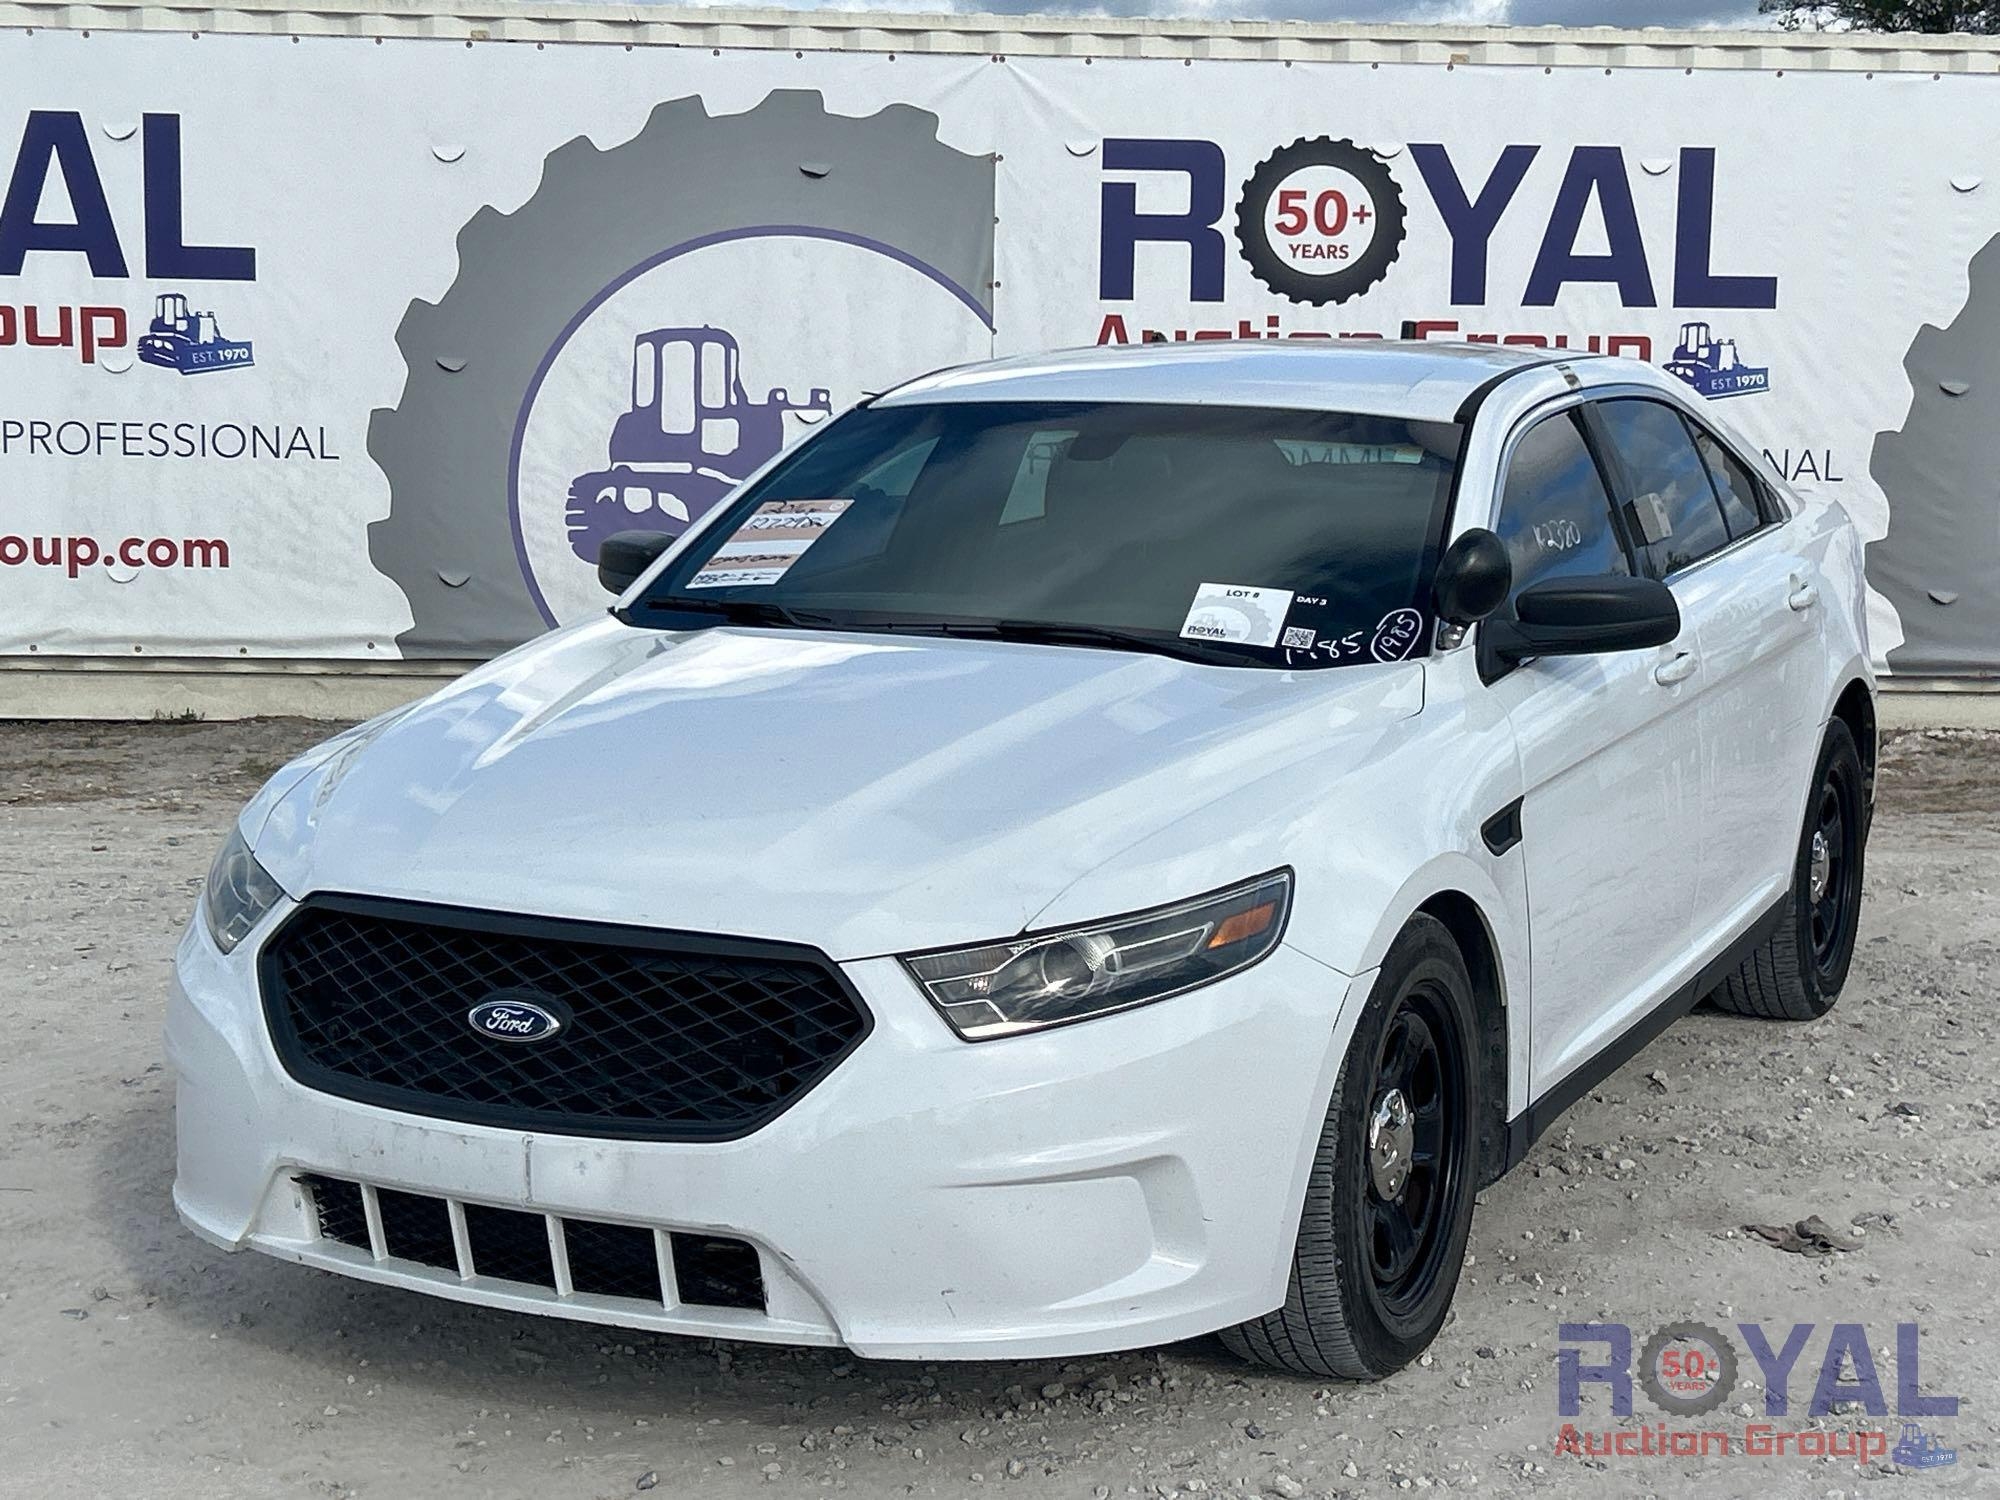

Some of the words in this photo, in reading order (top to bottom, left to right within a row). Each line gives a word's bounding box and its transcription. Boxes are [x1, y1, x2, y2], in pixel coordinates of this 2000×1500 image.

[1274, 190, 1372, 236] 50+
[1100, 138, 1778, 309] ROYAL
[1289, 244, 1349, 259] YEARS
[217, 347, 249, 361] 1970
[1736, 374, 1765, 387] 1970
[3, 420, 340, 461] PROFESSIONAL
[1226, 589, 1251, 598] LOT
[1296, 596, 1319, 605] DAY
[1187, 625, 1227, 636] ROYAL
[485, 1007, 535, 1034] Ford
